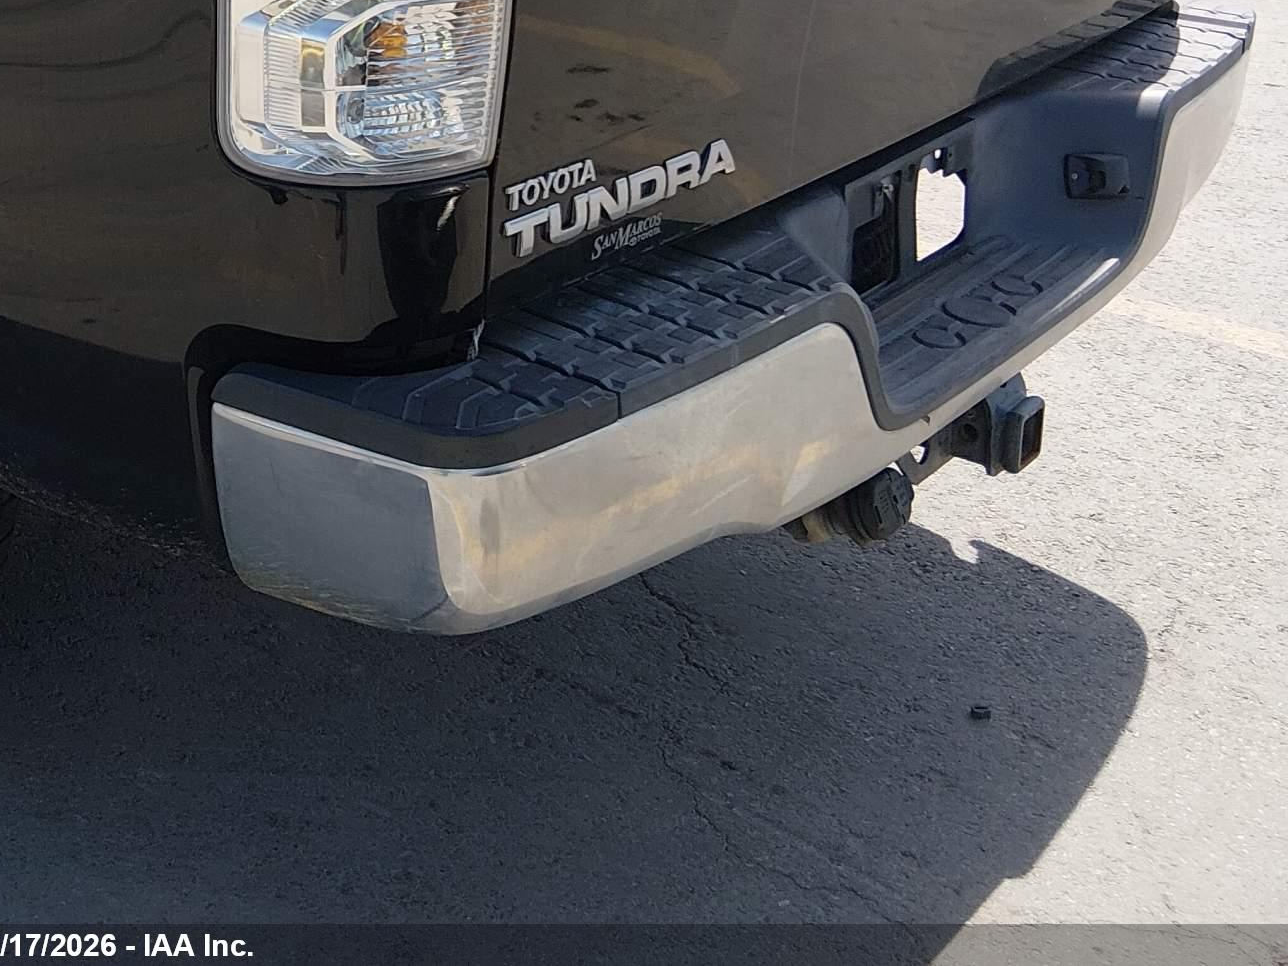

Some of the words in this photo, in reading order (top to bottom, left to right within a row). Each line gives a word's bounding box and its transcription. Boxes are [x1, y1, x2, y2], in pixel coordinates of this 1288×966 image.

[503, 138, 736, 258] TUNDRA
[504, 159, 597, 211] TOYOTA
[591, 230, 618, 261] SAN
[614, 211, 663, 250] MARCOS
